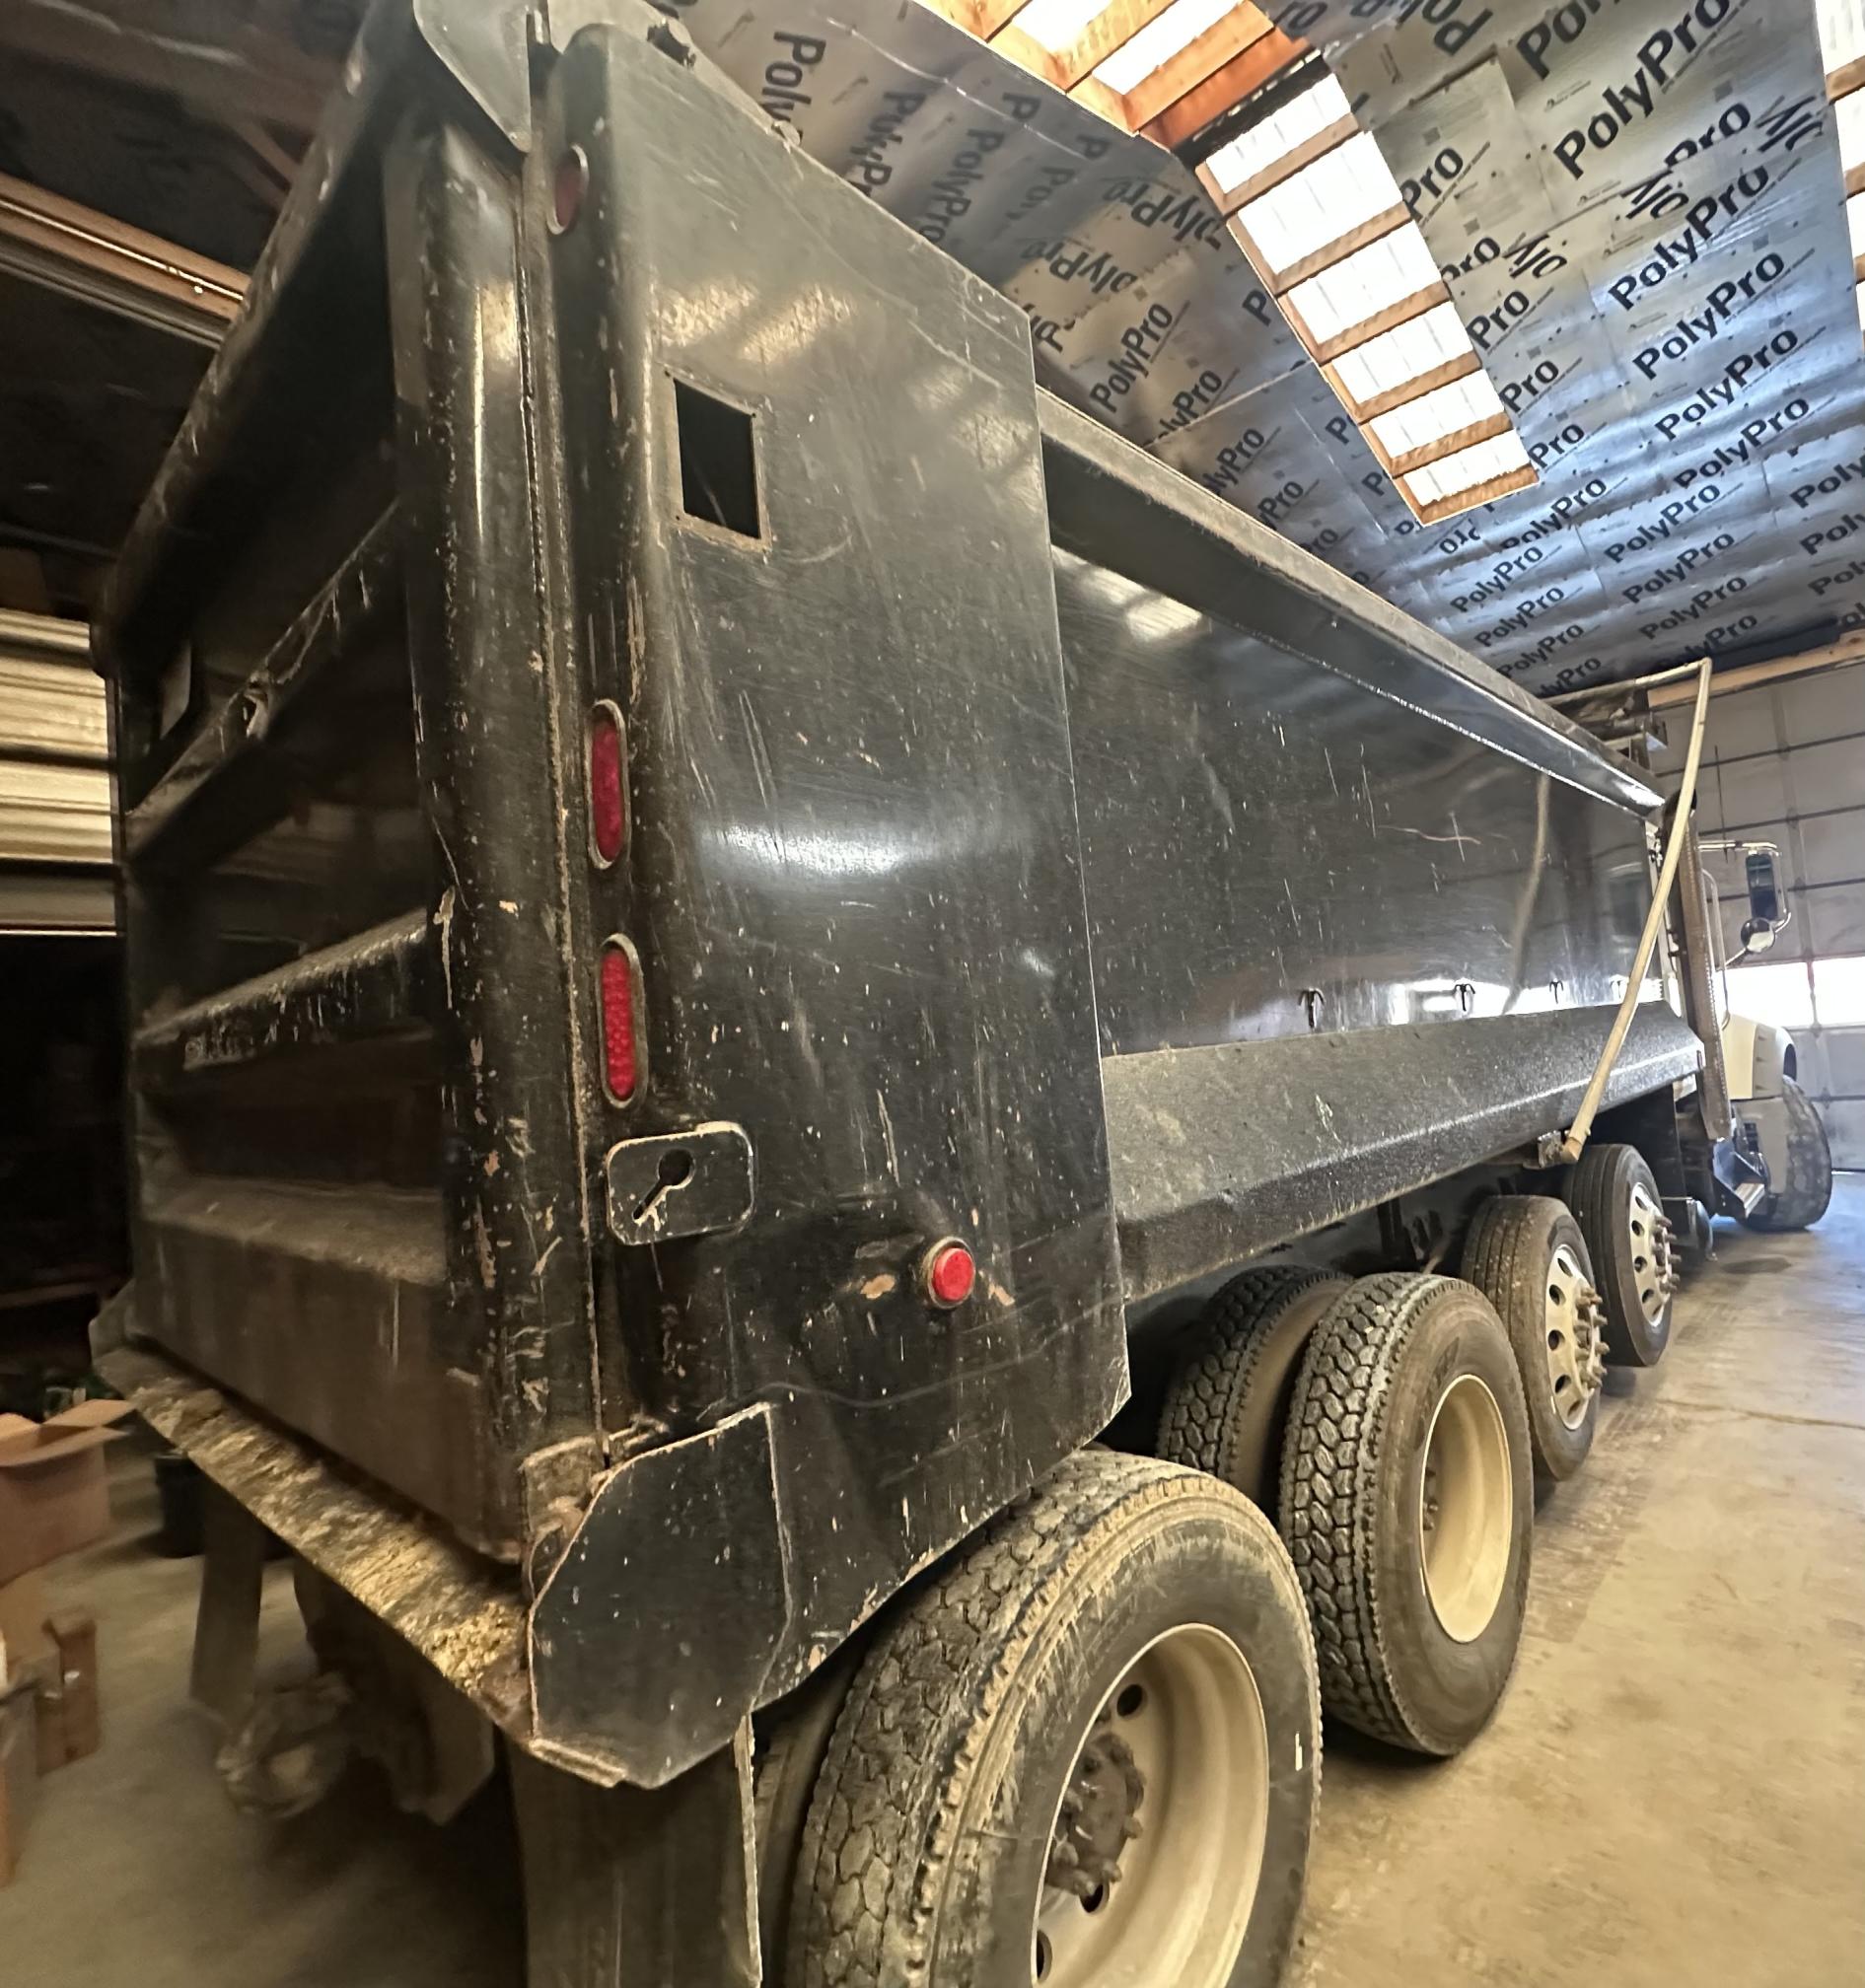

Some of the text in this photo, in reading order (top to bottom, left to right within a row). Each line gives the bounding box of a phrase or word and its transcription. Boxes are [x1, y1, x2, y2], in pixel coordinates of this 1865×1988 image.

[1553, 0, 1730, 180] PolyPro
[1608, 165, 1769, 312] PolyPro
[1466, 290, 1530, 351] Pro
[1632, 252, 1785, 381] PolyPro
[1089, 303, 1173, 413] PolyPro
[1499, 360, 1559, 414] Pro
[1654, 329, 1798, 442] PolyPro
[1326, 415, 1357, 445] P
[1529, 423, 1585, 469] Pro
[1673, 398, 1809, 489] PolyPro
[1604, 484, 1721, 564] PolyPro
[1450, 546, 1543, 613] PolyPro
[1622, 533, 1735, 604] PolyPro
[1807, 560, 1865, 596] Pol
[1473, 587, 1565, 648] PolyPro
[1638, 577, 1747, 640] PolyPro
[1496, 624, 1584, 678] PolyPro
